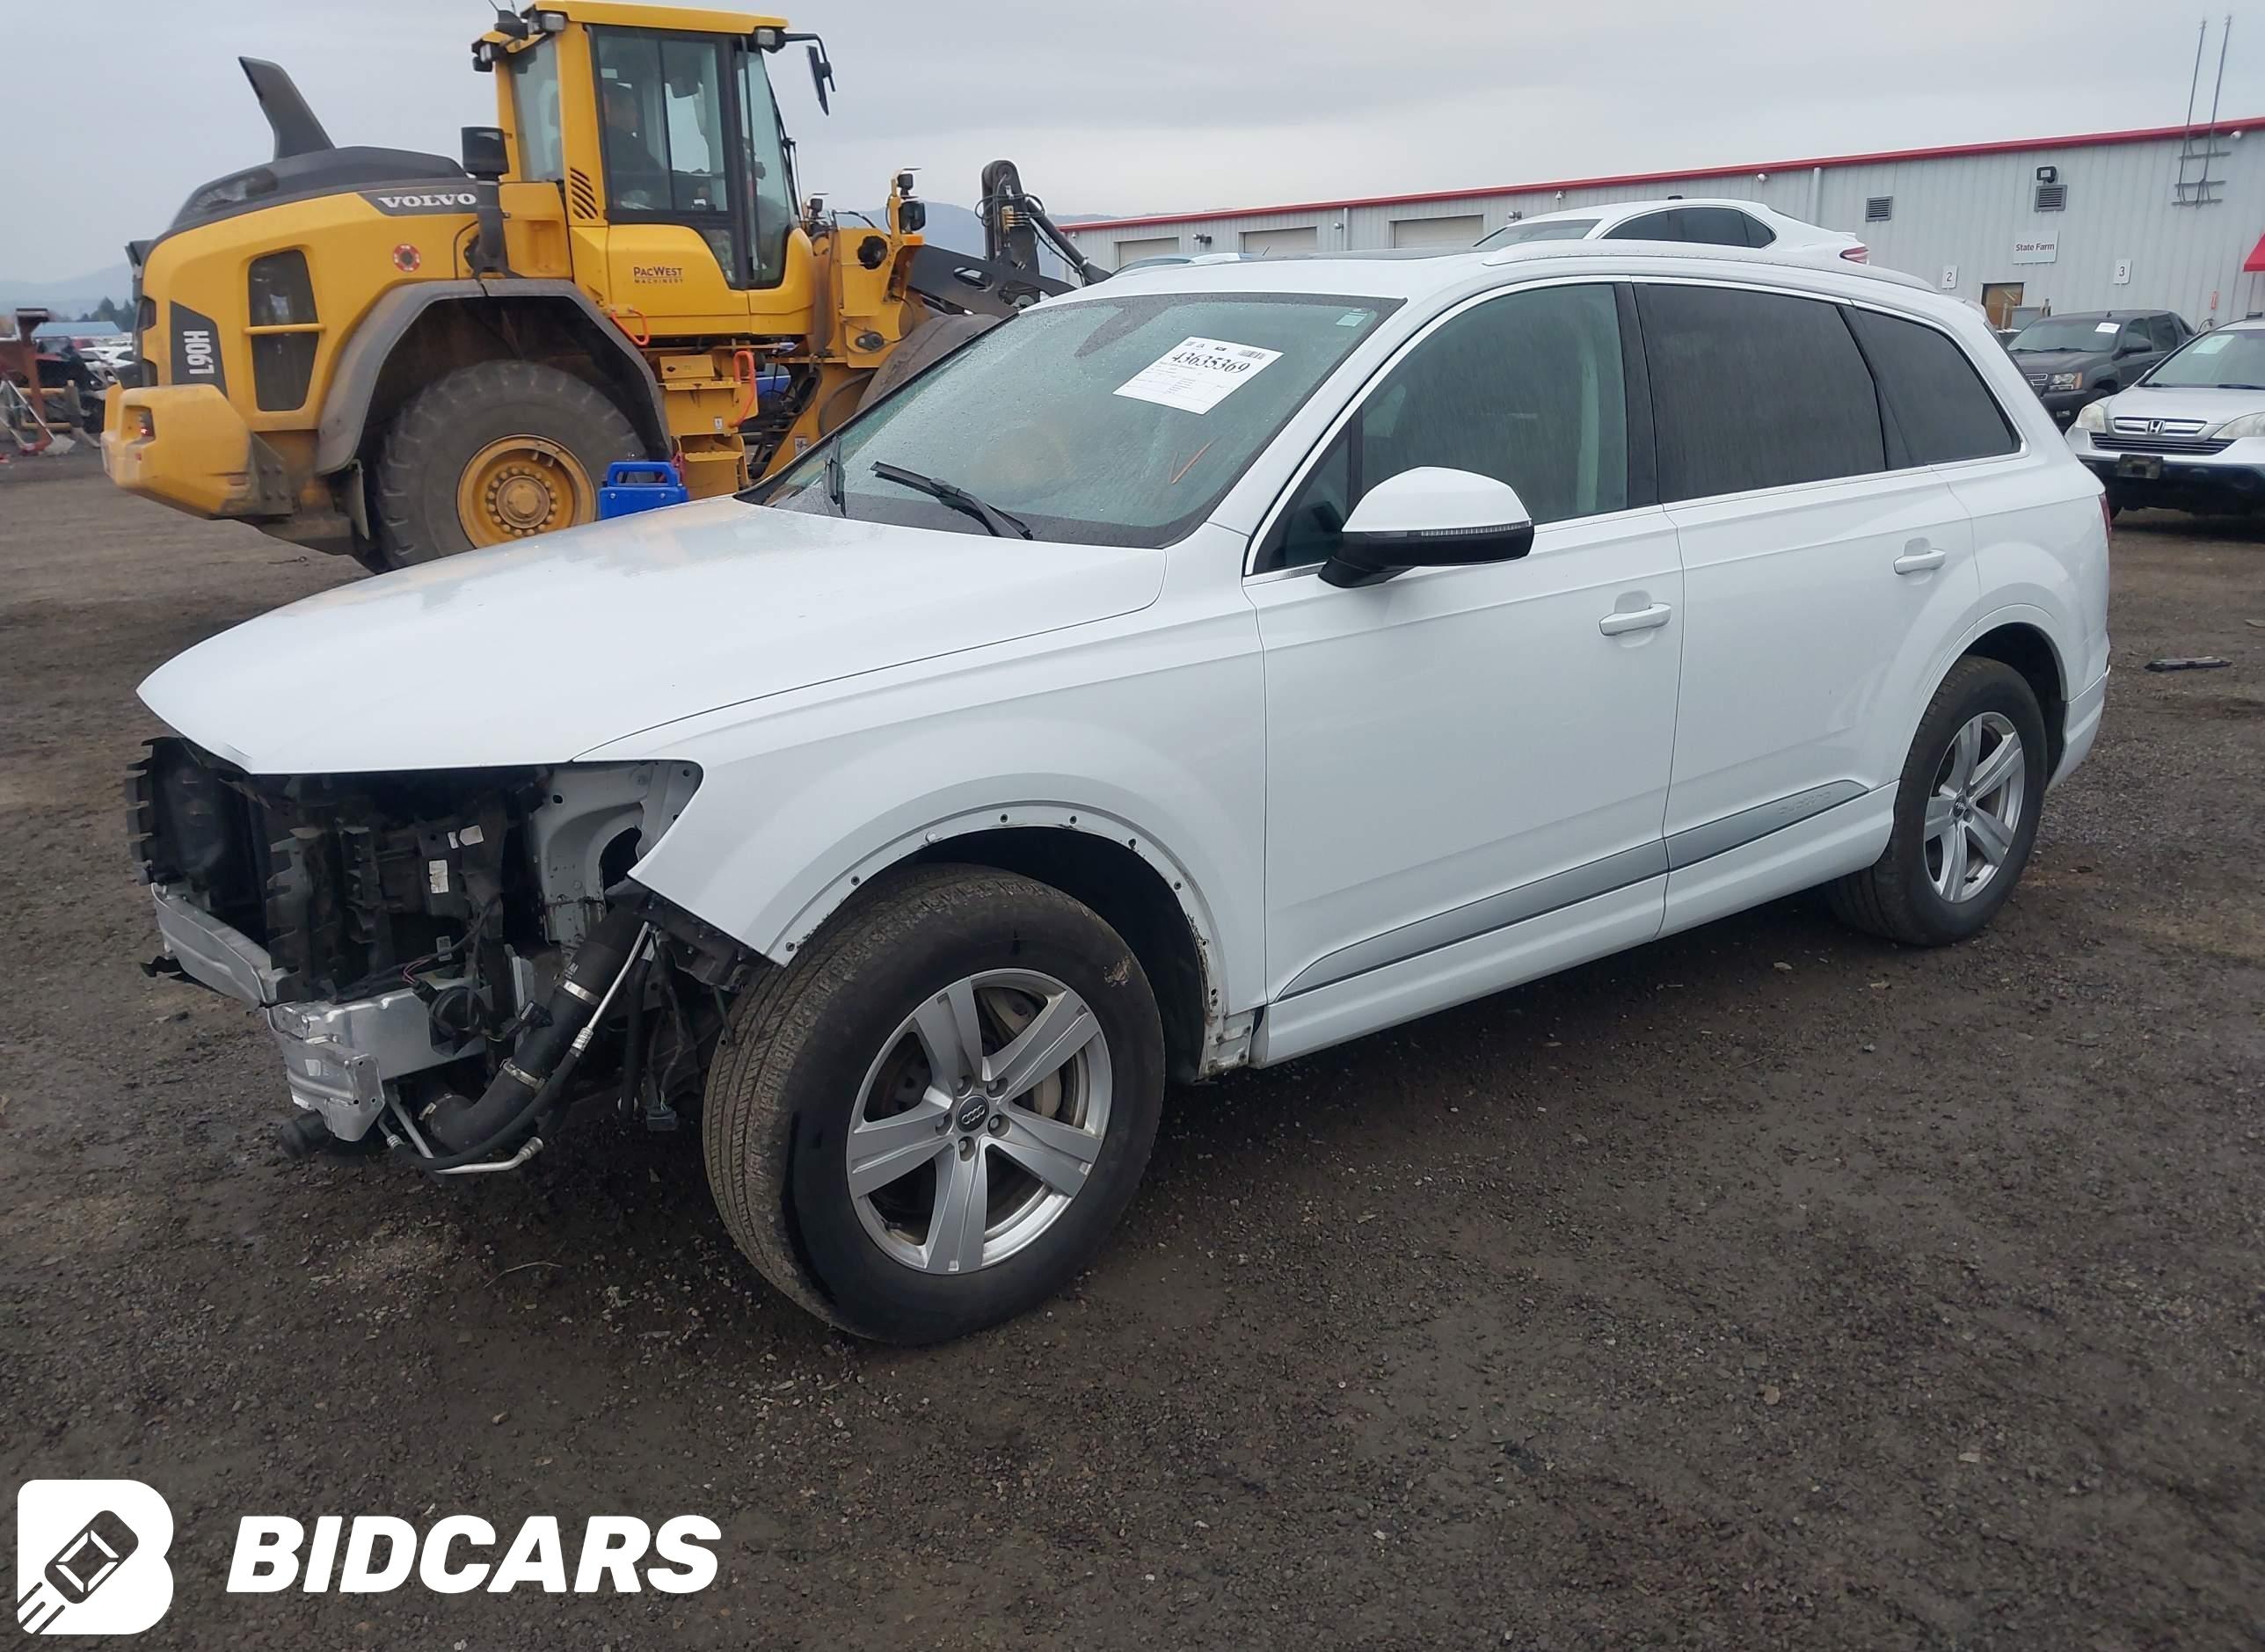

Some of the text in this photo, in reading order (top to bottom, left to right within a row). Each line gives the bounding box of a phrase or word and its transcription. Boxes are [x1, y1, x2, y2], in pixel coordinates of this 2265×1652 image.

[377, 193, 477, 207] VOLVO
[1946, 272, 1953, 282] 2
[2118, 266, 2125, 277] 3
[183, 331, 215, 375] L90H
[1172, 352, 1251, 374] 43635369
